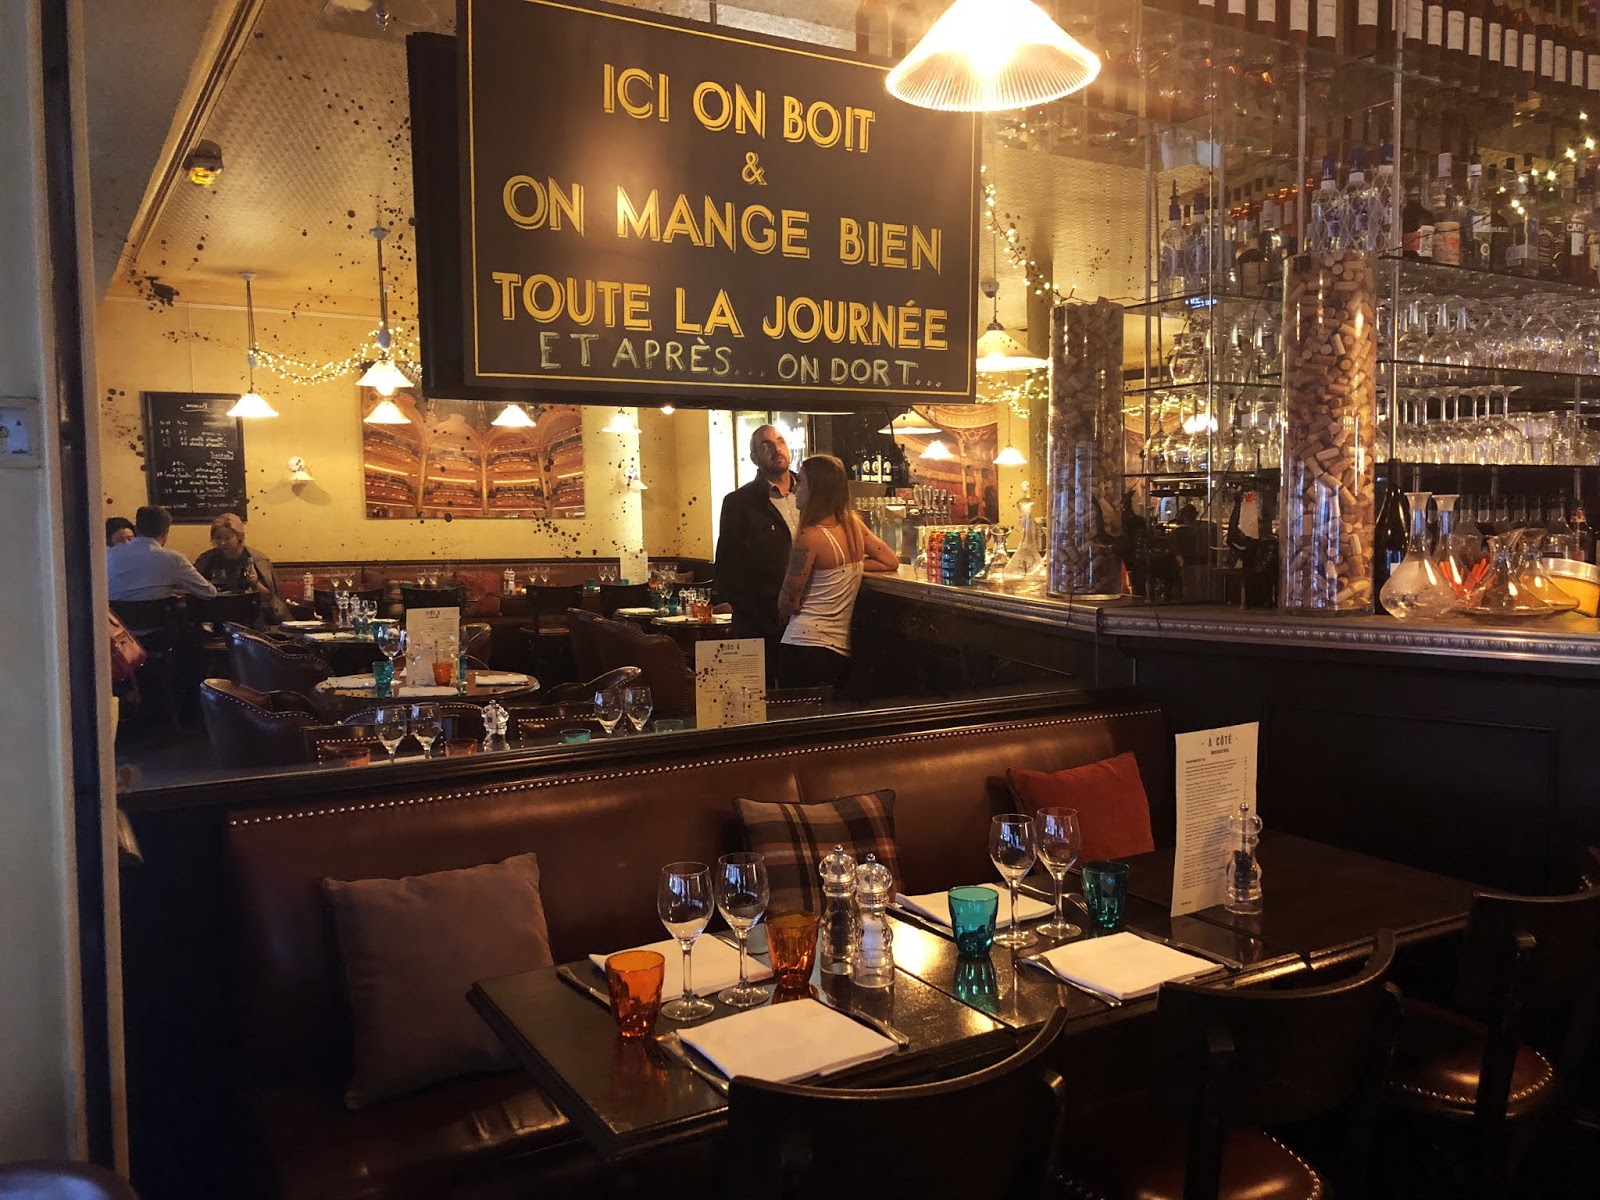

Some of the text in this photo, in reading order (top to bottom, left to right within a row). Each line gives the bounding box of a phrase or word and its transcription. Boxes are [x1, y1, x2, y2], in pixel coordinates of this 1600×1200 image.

[604, 63, 876, 153] ICI ON BOIT
[741, 151, 767, 186] &
[503, 174, 942, 275] ON MANGE BIEN
[492, 271, 948, 351] TOUTE LA JOURNÉE
[539, 331, 599, 369] ET
[777, 353, 820, 385] ON
